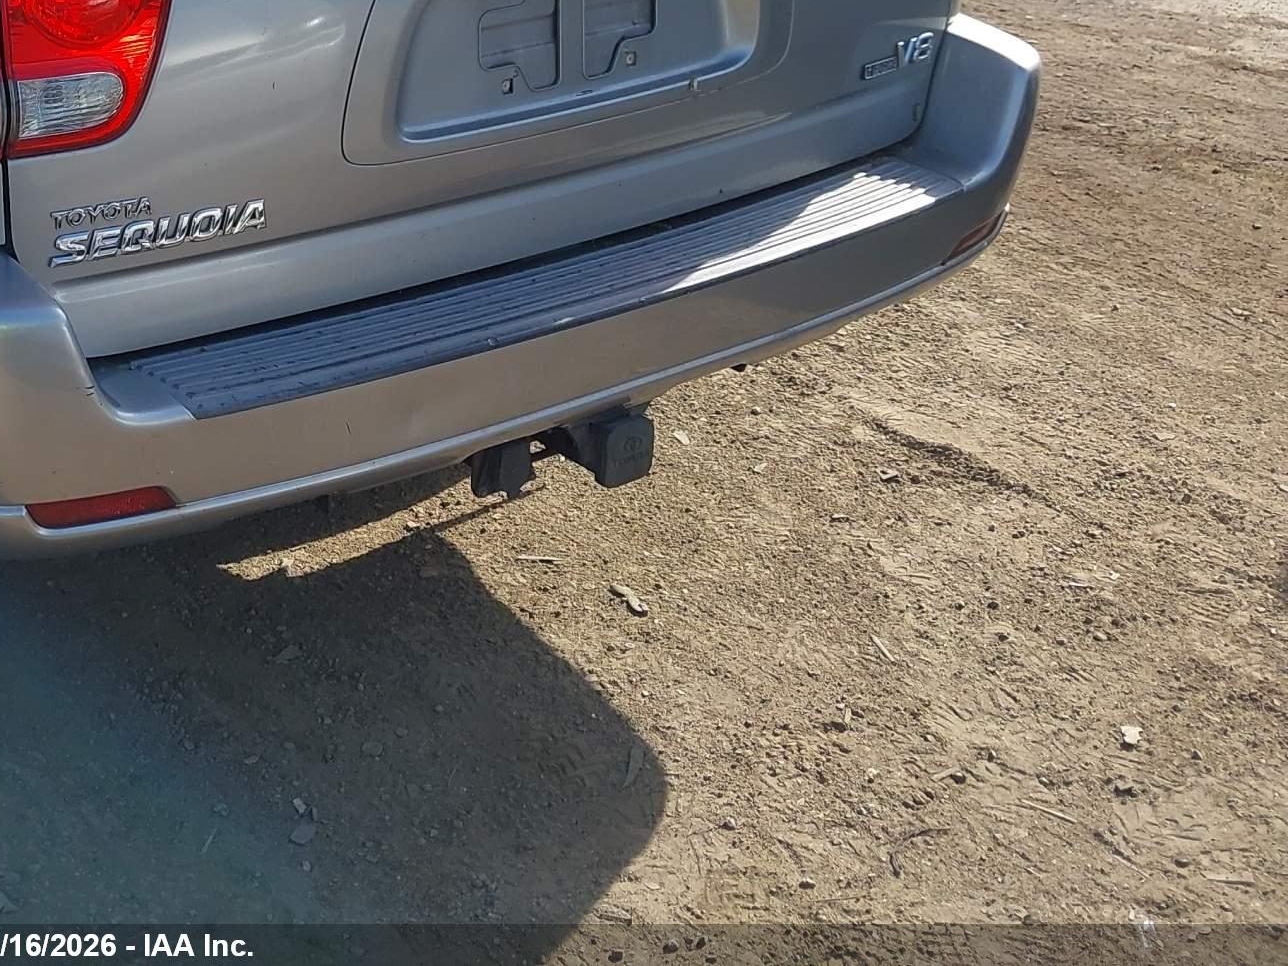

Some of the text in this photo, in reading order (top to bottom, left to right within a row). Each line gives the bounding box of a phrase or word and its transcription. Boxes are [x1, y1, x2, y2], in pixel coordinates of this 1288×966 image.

[895, 31, 934, 69] V8
[50, 196, 153, 229] TOYOTA
[48, 199, 267, 268] SEQUOIA
